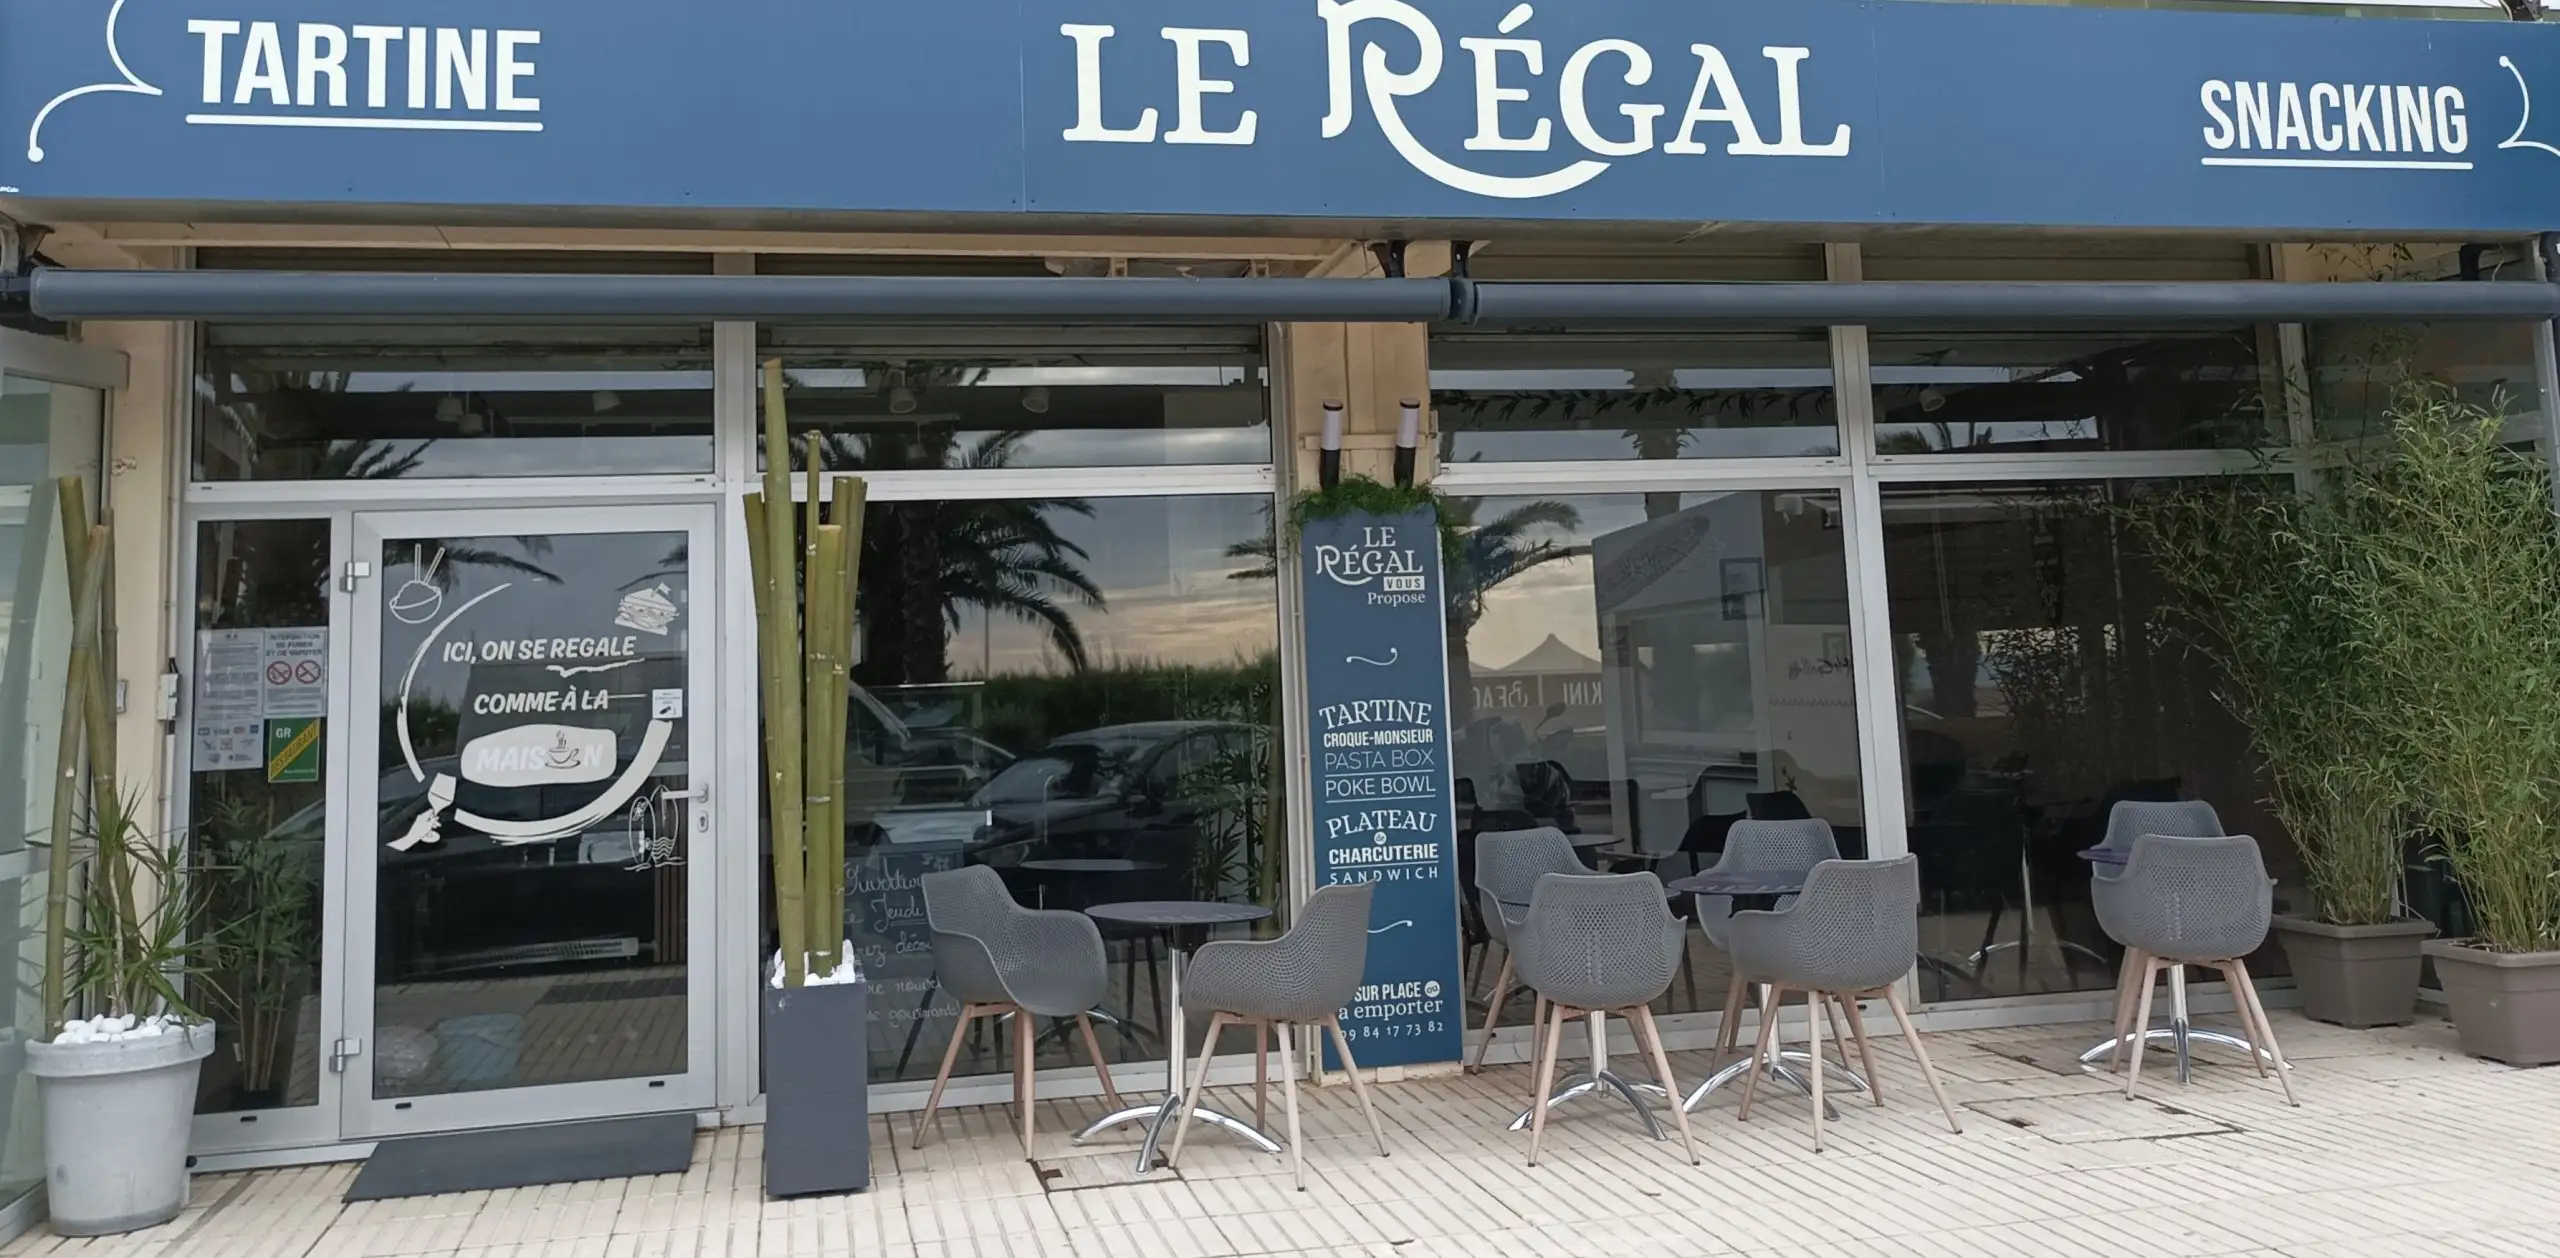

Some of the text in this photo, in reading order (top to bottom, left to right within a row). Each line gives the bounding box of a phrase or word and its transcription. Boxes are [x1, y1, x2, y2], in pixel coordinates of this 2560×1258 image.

[187, 18, 541, 112] TARTINE
[1060, 0, 1851, 199] LE RÉGAL
[2200, 80, 2469, 154] SNACKING
[1363, 526, 1396, 548] LE
[1315, 544, 1424, 586] RÉGAL
[1386, 578, 1422, 589] VOUS
[1368, 591, 1426, 607] Propose
[443, 636, 637, 664] ICI, ON SE REGALE
[473, 685, 609, 714] COMME À LA
[1319, 699, 1432, 730] TARTINE
[275, 727, 291, 738] GR
[1323, 728, 1434, 748] CROQUE-MONSIEUR
[476, 742, 604, 773] MAISN
[1324, 748, 1435, 771] PASTA BOX
[1325, 775, 1437, 797] POKE BOWL
[1326, 809, 1437, 839] PLATEAU
[1328, 843, 1439, 865] CHARCUTERIE
[1329, 866, 1438, 885] SANDWICH
[1354, 984, 1380, 1002] SUR
[1382, 981, 1422, 1000] PLACE
[1354, 999, 1444, 1021] emporter
[1363, 1025, 1380, 1038] 84
[1386, 1025, 1400, 1037] 17
[1405, 1024, 1421, 1036] 73
[1428, 1020, 1444, 1032] 82
